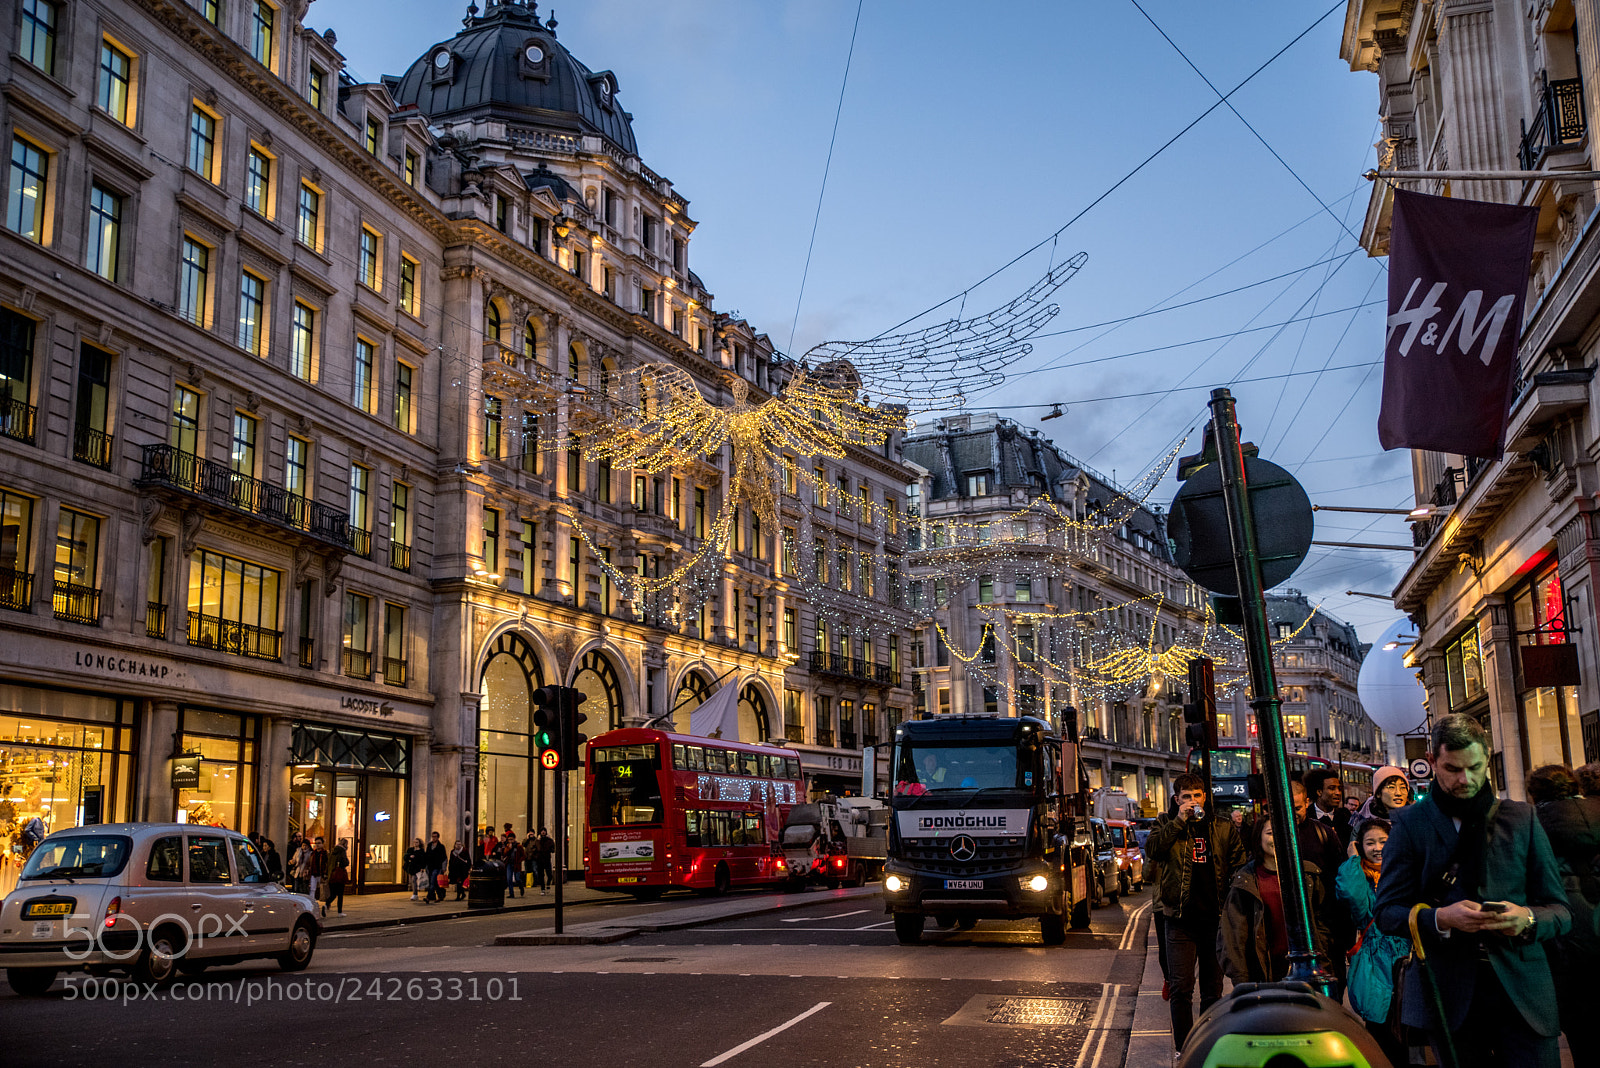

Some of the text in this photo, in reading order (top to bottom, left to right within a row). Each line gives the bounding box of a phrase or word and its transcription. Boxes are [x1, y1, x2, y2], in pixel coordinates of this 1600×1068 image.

[1387, 277, 1515, 366] H&M
[75, 651, 169, 679] LONGCHAMP
[341, 696, 379, 713] LACOSTE
[828, 756, 843, 769] TED
[617, 765, 632, 778] 94
[1233, 784, 1245, 794] 23
[923, 816, 1007, 828] DONOGHUE
[53, 903, 71, 913] ULB
